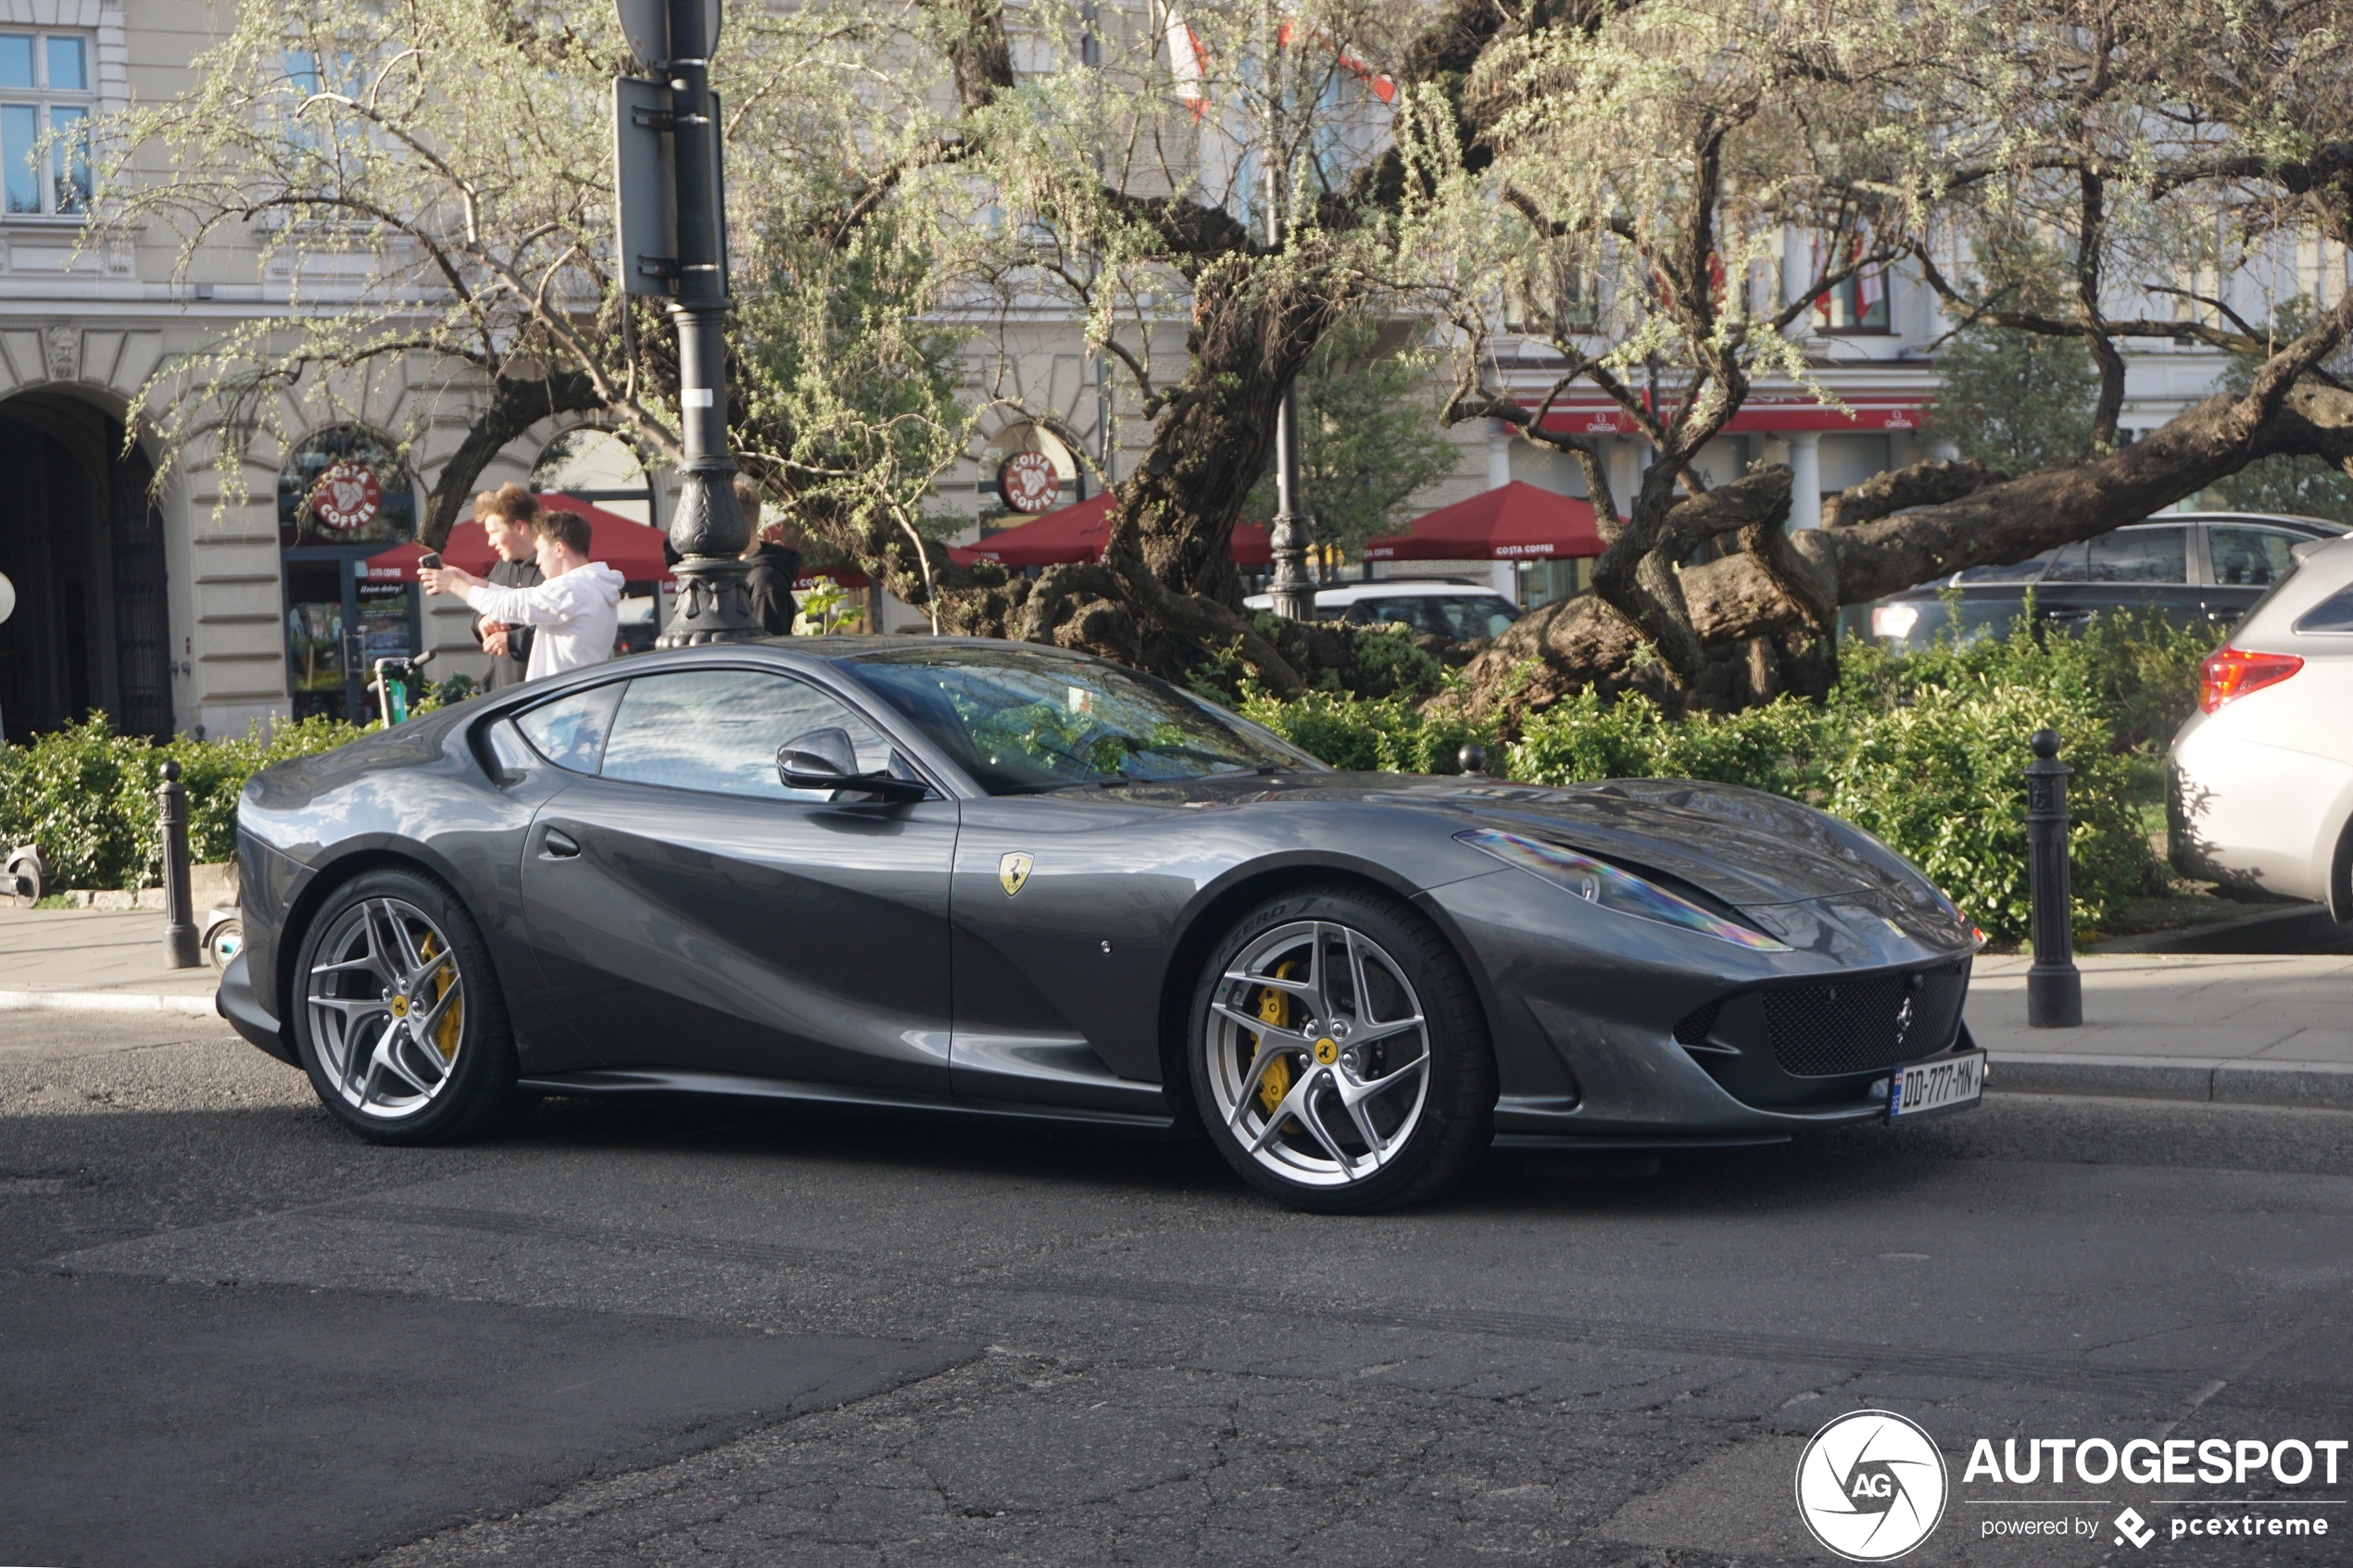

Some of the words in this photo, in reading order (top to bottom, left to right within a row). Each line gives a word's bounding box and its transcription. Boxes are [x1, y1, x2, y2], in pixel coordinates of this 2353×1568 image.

[1587, 422, 1617, 433] OMEGA
[1884, 419, 1913, 429] OMEGA
[1013, 453, 1051, 471] COSTA
[1011, 488, 1056, 511] COFFEE
[321, 502, 377, 528] COFFEE
[1495, 546, 1524, 556] COSTA
[1524, 544, 1554, 554] COFFEE
[1230, 904, 1287, 947] ZERO
